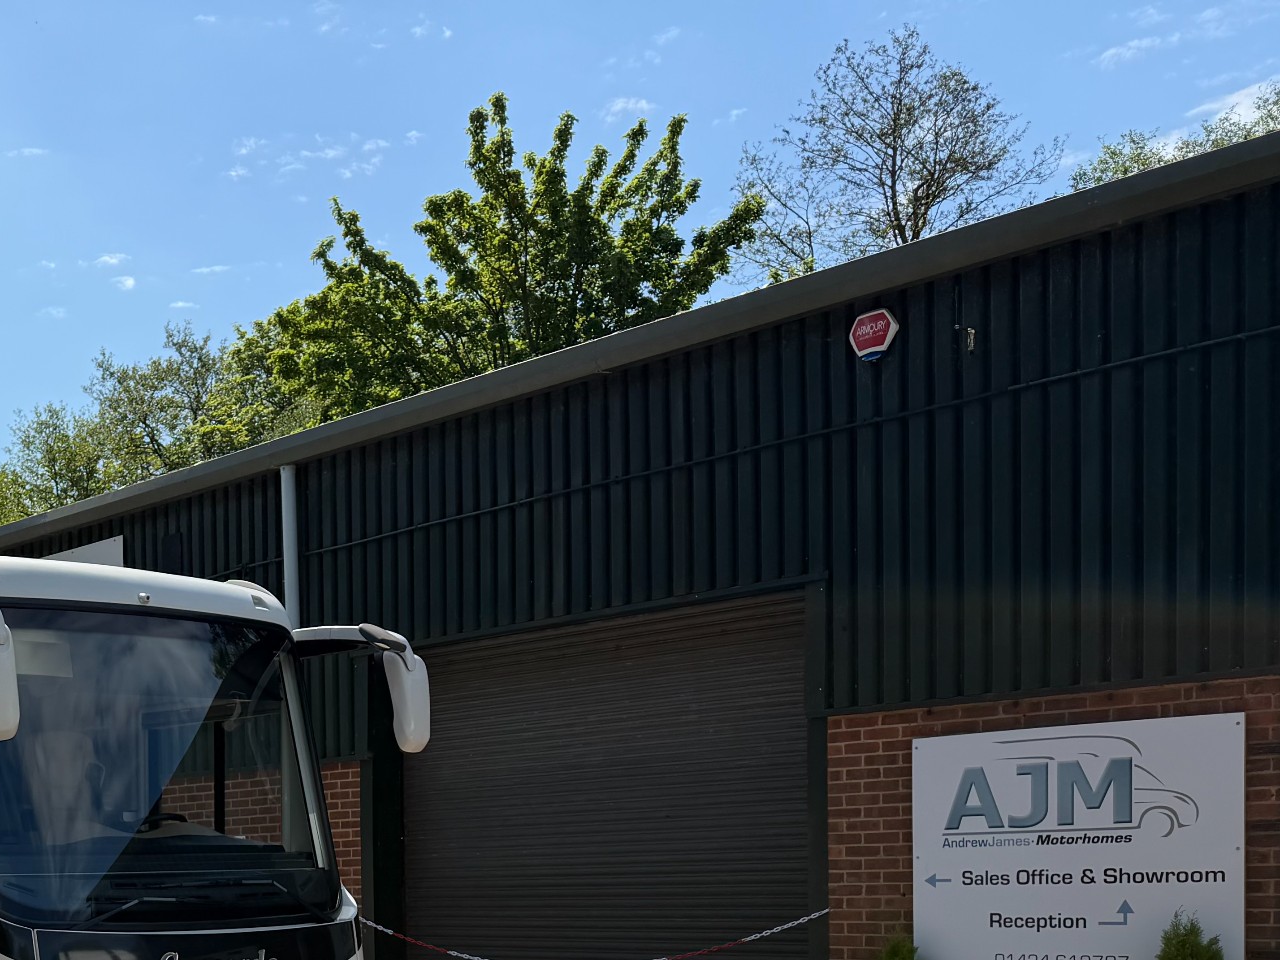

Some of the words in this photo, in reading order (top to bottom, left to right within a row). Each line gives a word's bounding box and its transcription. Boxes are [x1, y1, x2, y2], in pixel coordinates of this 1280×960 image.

[943, 756, 1134, 830] AJM
[961, 870, 1011, 886] Sales
[1015, 869, 1073, 885] Office
[1080, 868, 1097, 884] &
[1103, 867, 1227, 884] Showroom
[989, 912, 1087, 933] Reception
